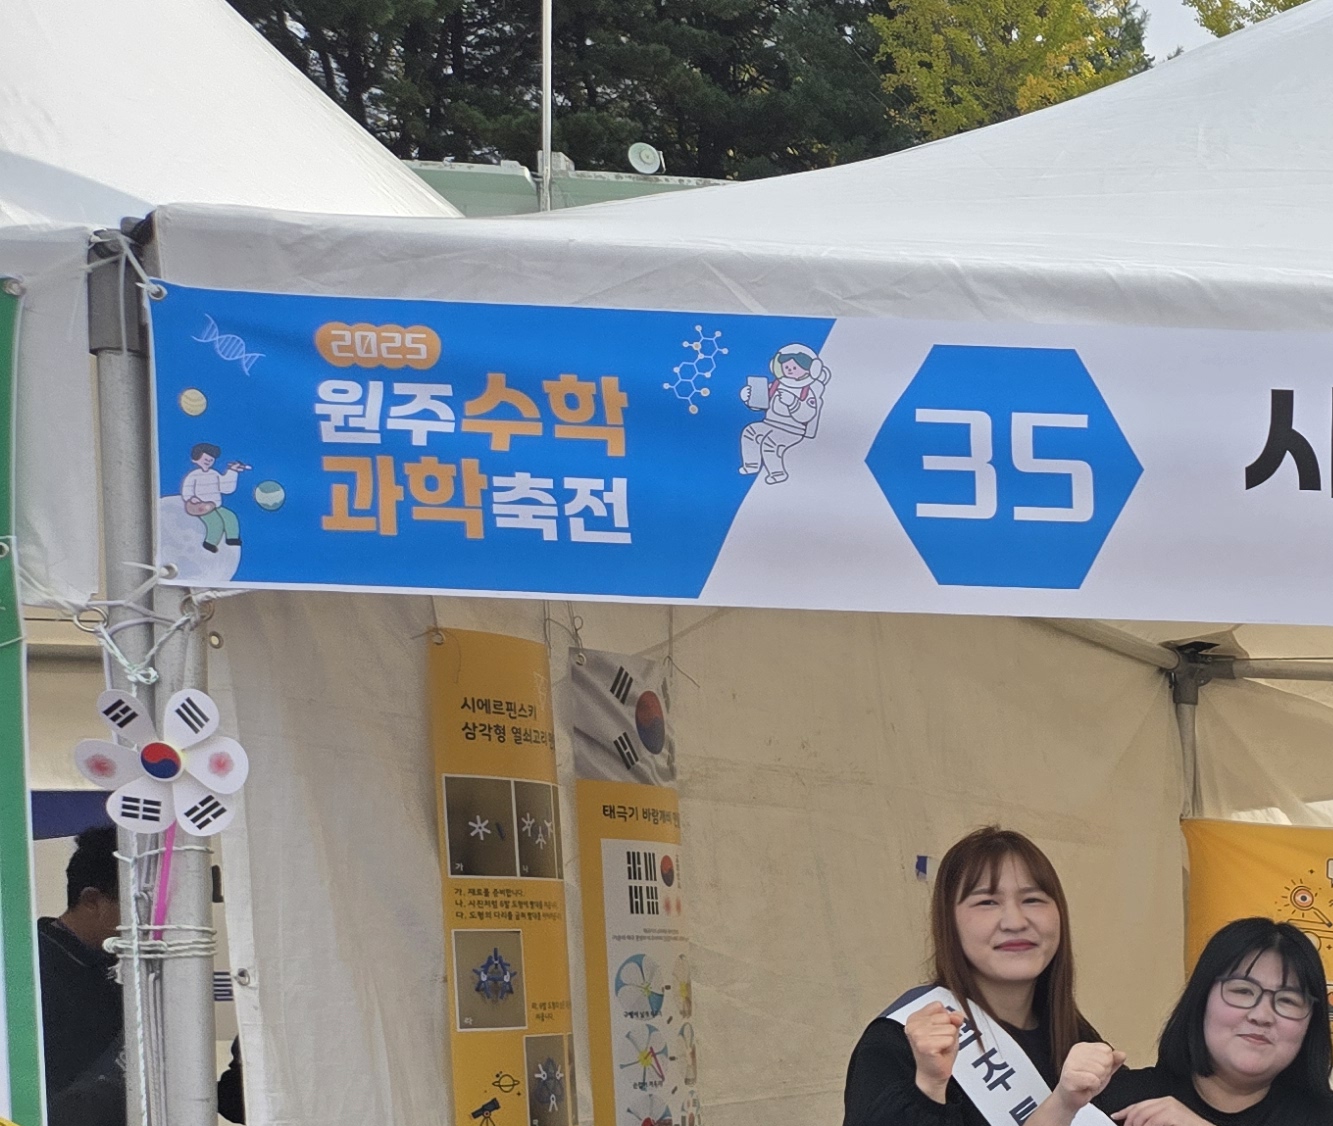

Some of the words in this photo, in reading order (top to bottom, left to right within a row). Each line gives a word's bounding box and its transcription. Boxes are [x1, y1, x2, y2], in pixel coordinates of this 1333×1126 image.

[329, 329, 429, 361] 2025
[915, 407, 1095, 523] 35
[461, 697, 537, 720] 시에르핀스키
[462, 722, 506, 743] 삼각형
[602, 805, 638, 822] 태극기
